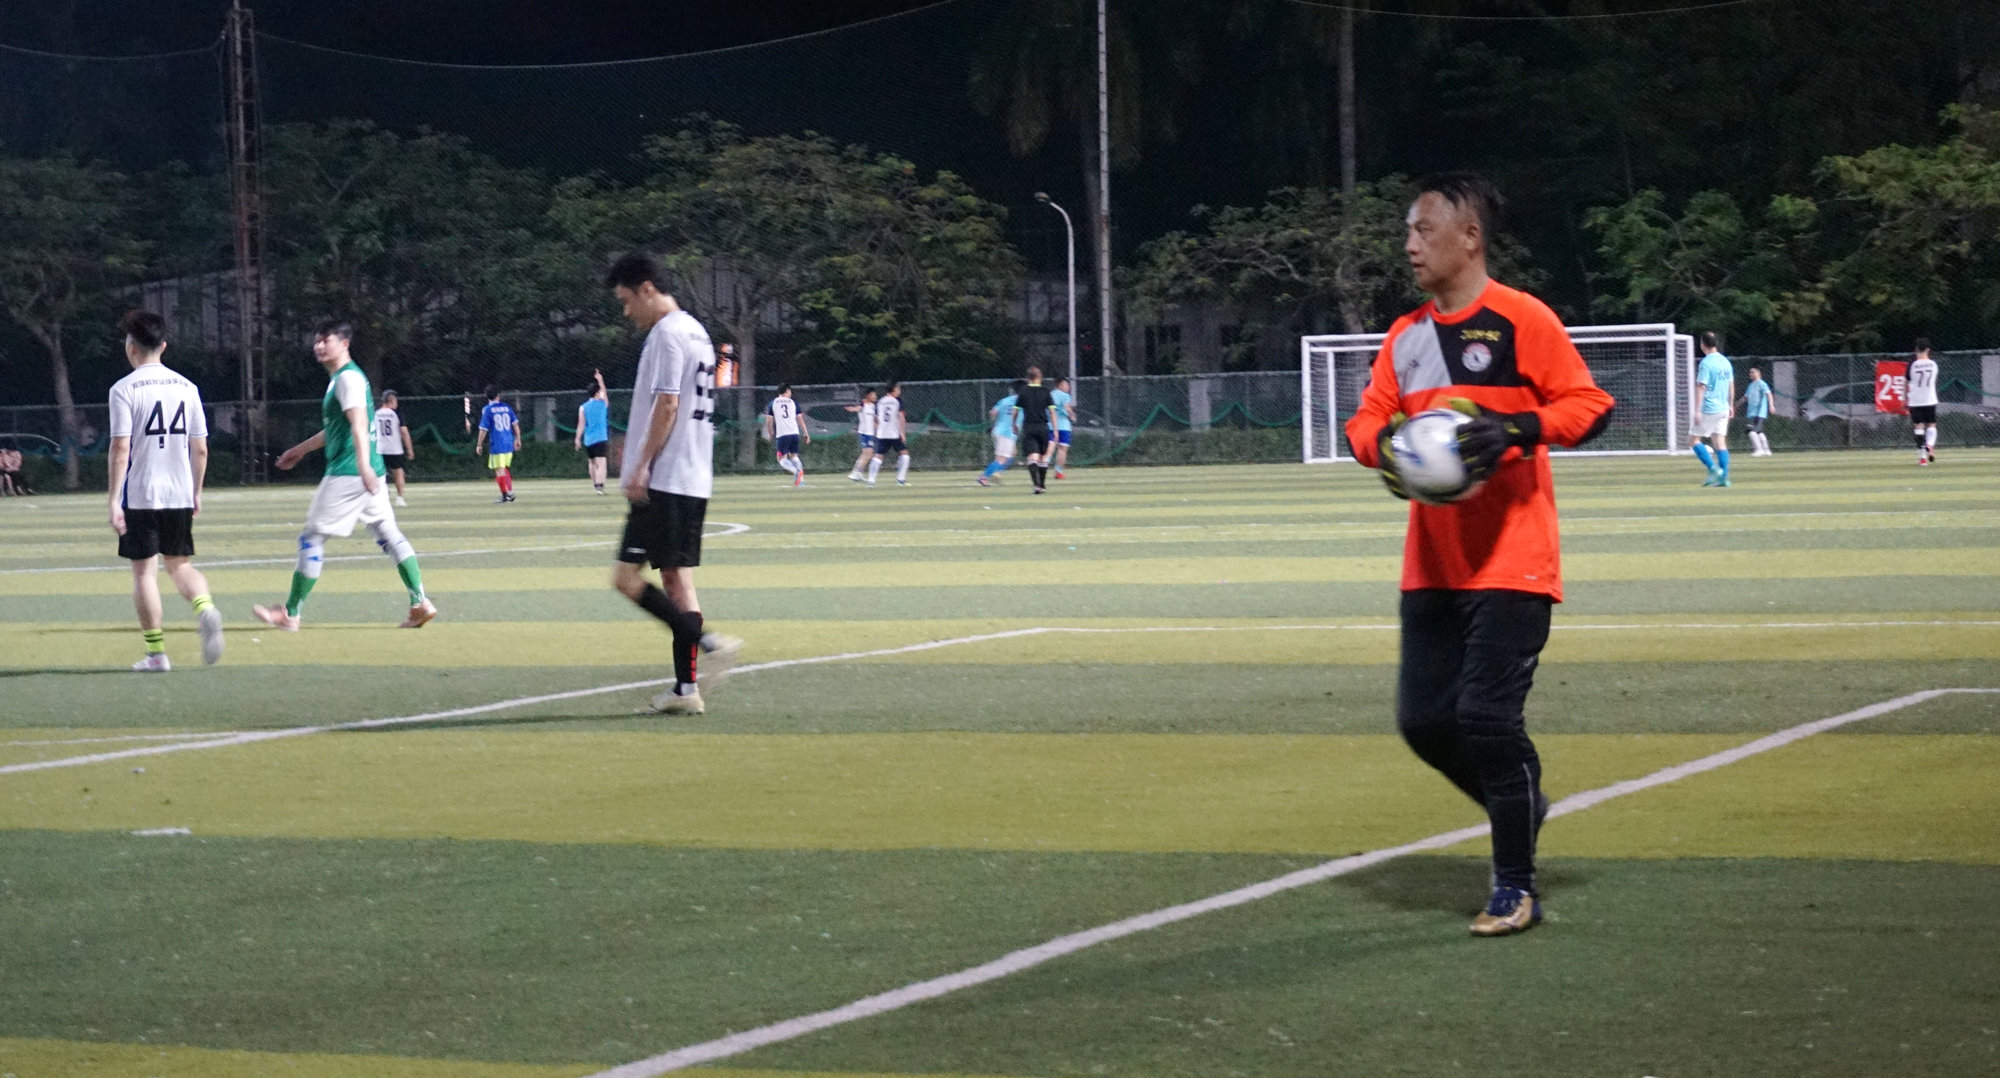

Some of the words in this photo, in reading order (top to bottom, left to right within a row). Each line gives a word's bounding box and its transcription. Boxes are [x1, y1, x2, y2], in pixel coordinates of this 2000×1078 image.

[1914, 369, 1932, 387] 77
[145, 400, 187, 435] 44
[780, 403, 789, 419] 3
[377, 419, 393, 437] 18
[493, 412, 511, 431] 80
